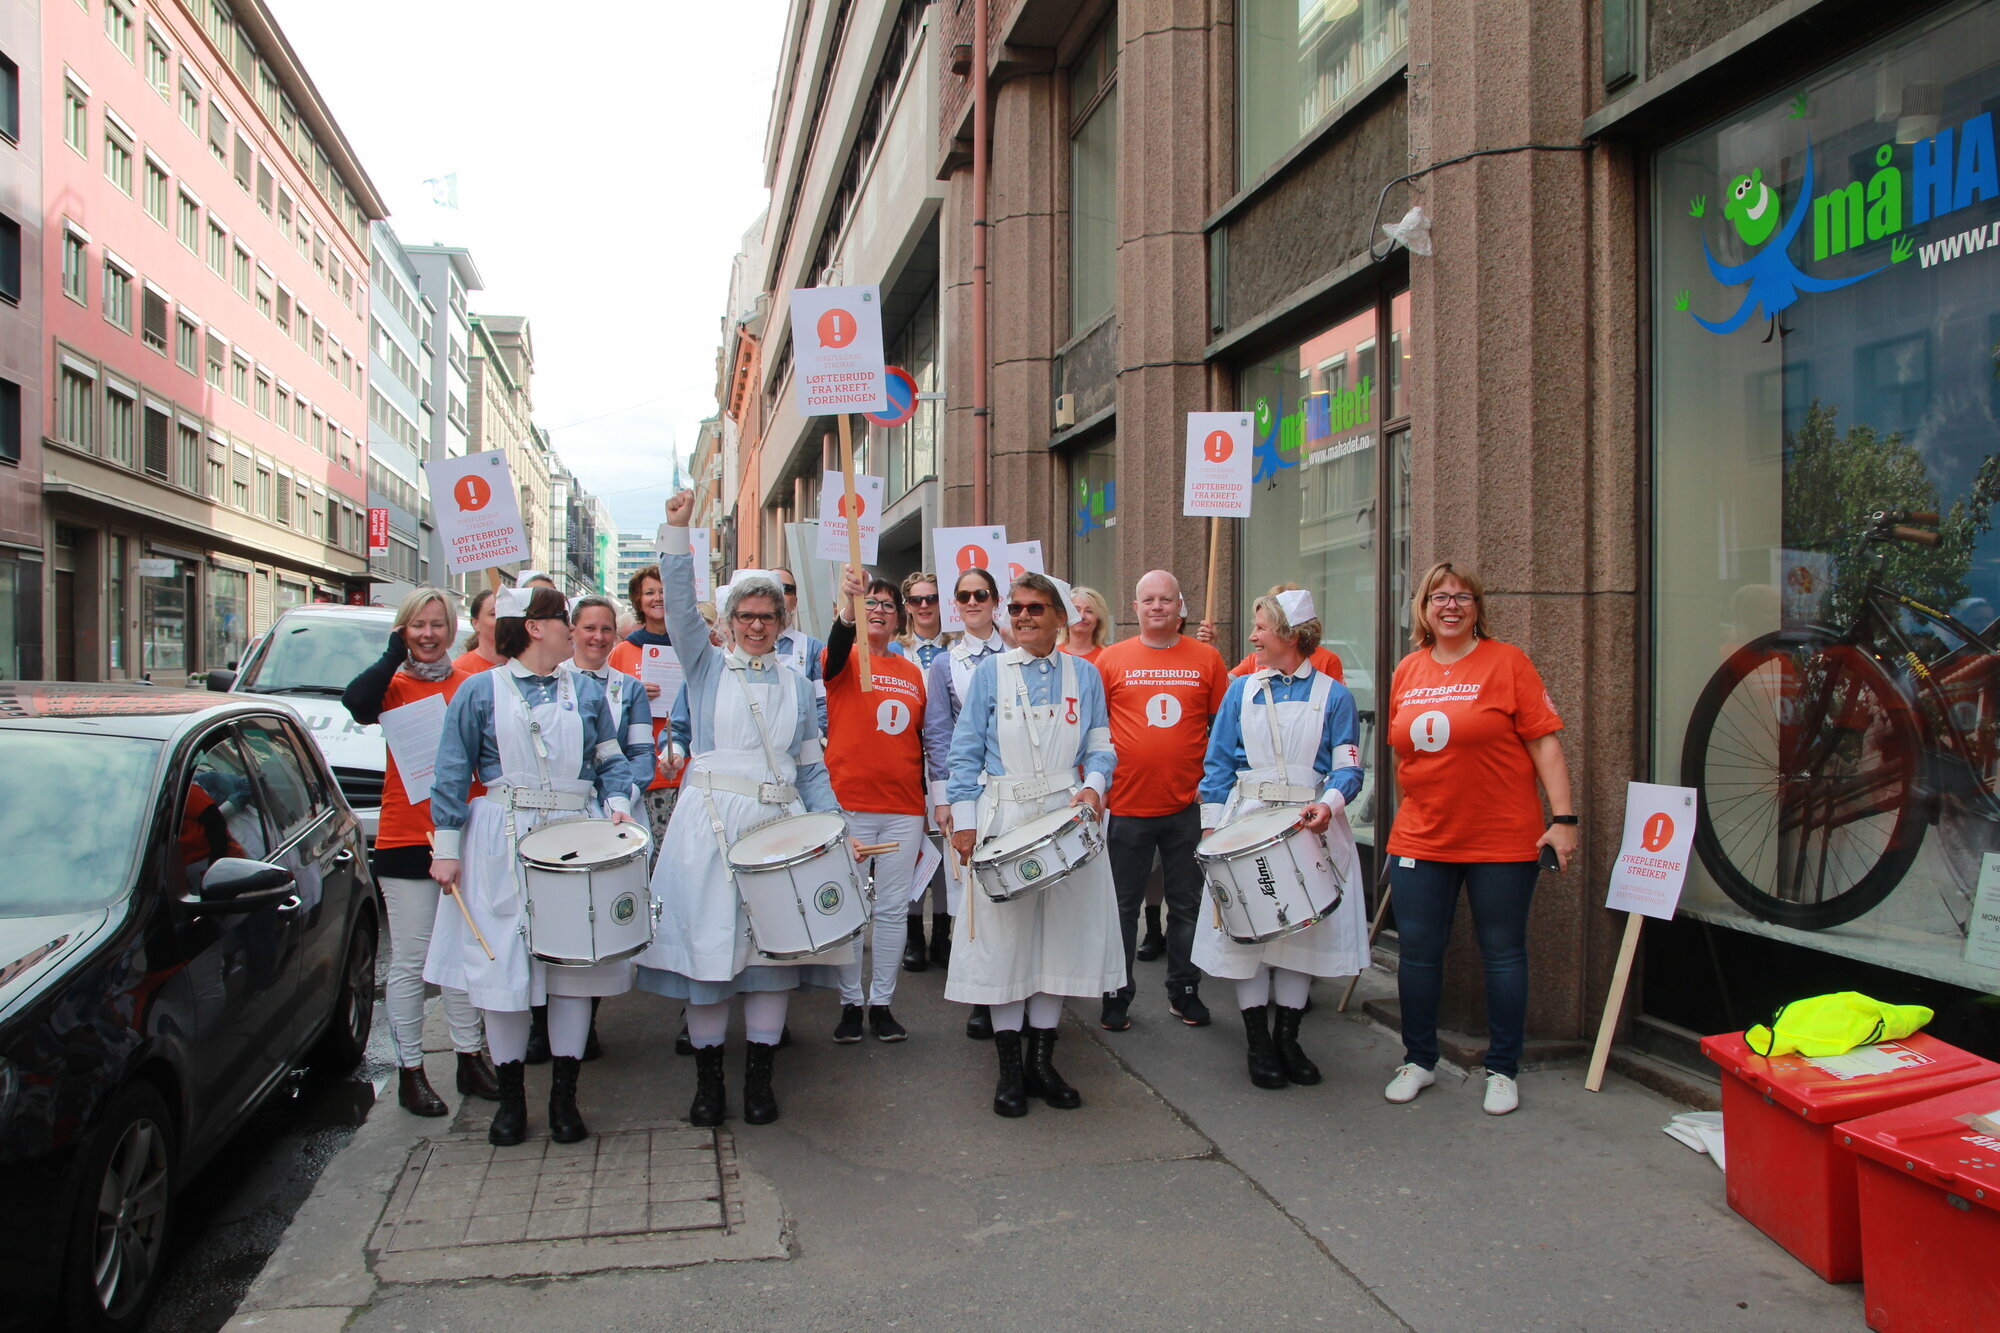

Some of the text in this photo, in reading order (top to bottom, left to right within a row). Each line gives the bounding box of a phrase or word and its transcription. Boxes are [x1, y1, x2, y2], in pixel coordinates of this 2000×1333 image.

[1814, 111, 1999, 262] må HA
[806, 372, 875, 385] LØFTEBRUDD
[812, 383, 871, 395] FRA KREFT-
[807, 393, 877, 406] FORENINGEN
[1308, 436, 1370, 466] www.mahadet.no
[1191, 483, 1244, 491] LØFTEBRUDD
[1190, 500, 1243, 509] FORENINGEN
[372, 510, 380, 536] Courses
[379, 509, 387, 546] Norwegian
[823, 521, 876, 533] SYKEPERNE
[451, 527, 515, 546] LØFTEBRUDD
[832, 529, 866, 539] STREER
[458, 537, 512, 554] FRA KREFT-
[456, 545, 519, 565] FORENINGEN
[1125, 669, 1201, 679] LØFTEBRUDD
[871, 674, 919, 694] FTEBRUDD
[1140, 679, 1200, 687] KREFTFORENINGEN
[1404, 683, 1481, 698] LØFTEBRUDD
[1620, 854, 1681, 871] SYKEPLEIERNE
[1627, 866, 1668, 881] STREIKER
